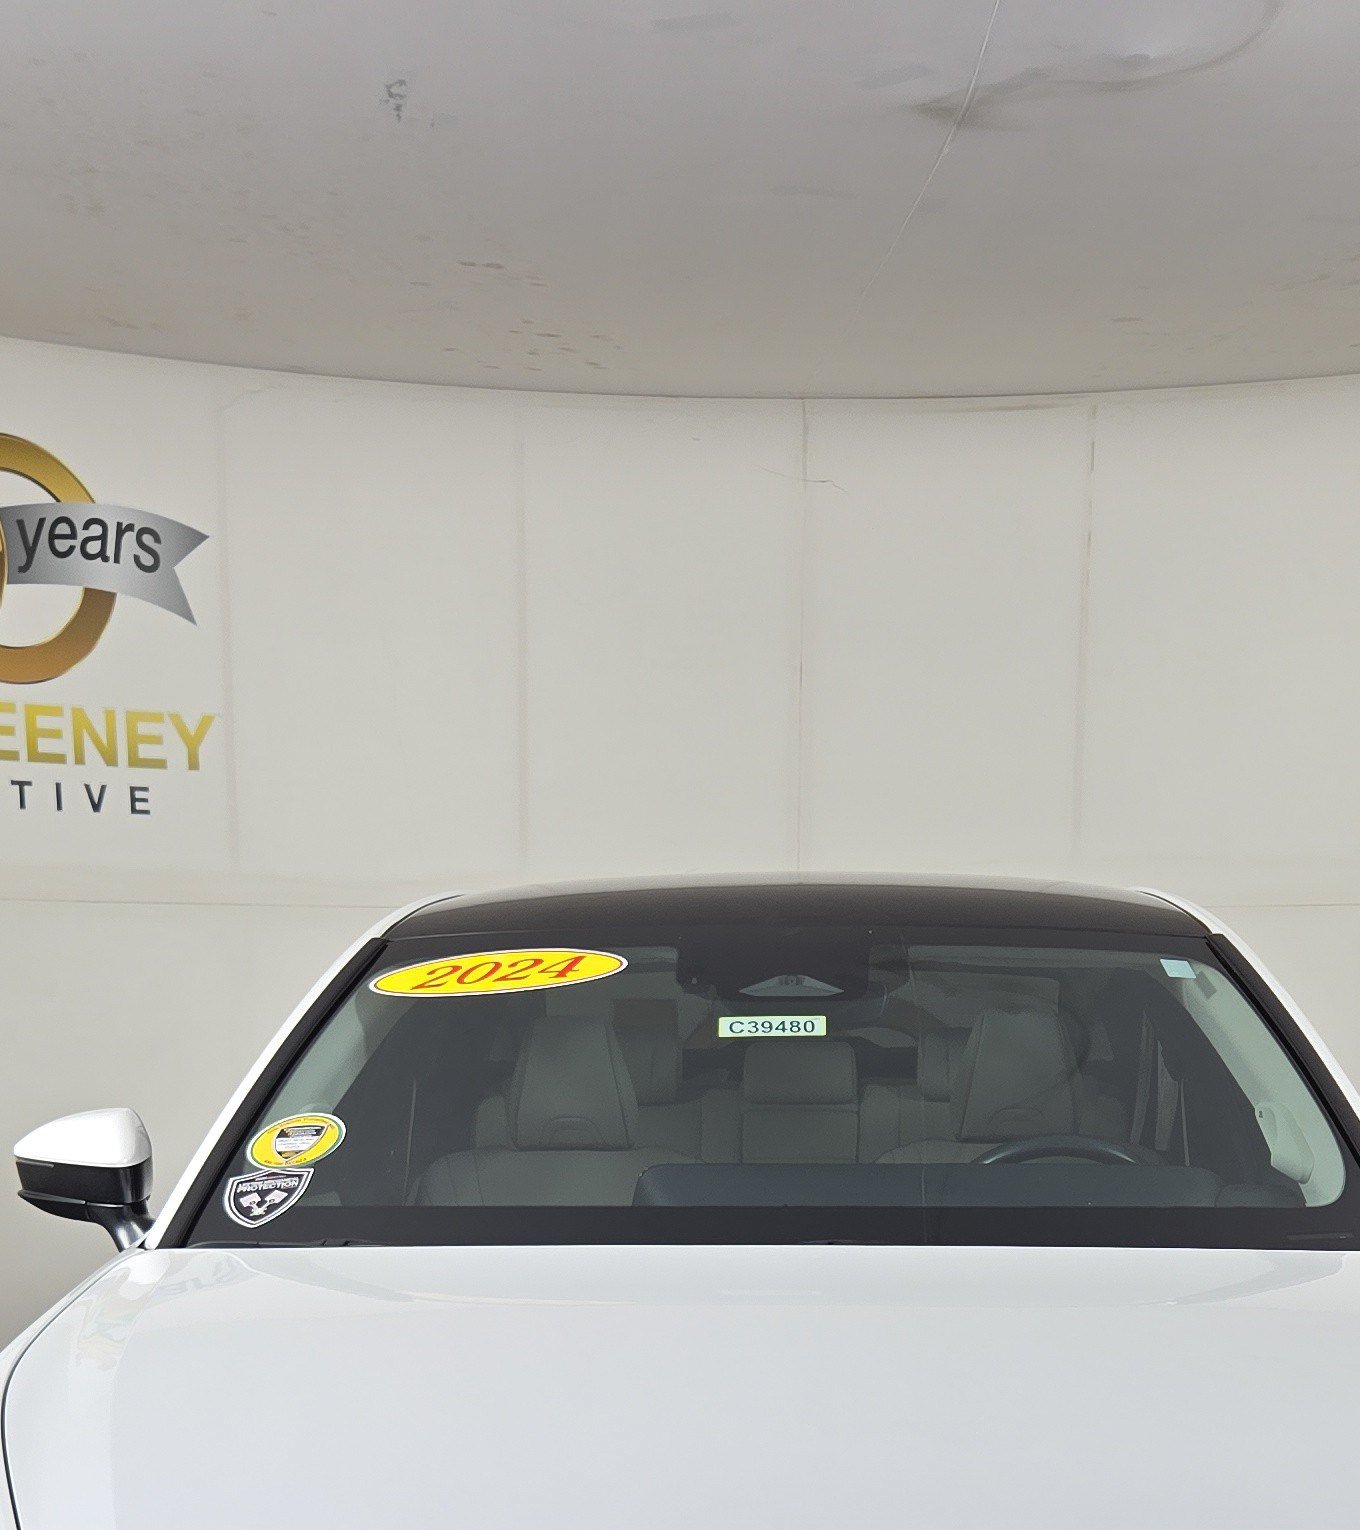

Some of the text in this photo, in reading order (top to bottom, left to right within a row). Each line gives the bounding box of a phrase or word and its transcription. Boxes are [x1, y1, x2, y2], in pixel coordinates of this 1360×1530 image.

[15, 516, 162, 573] years
[410, 955, 586, 990] 2024
[729, 1020, 815, 1034] C39480
